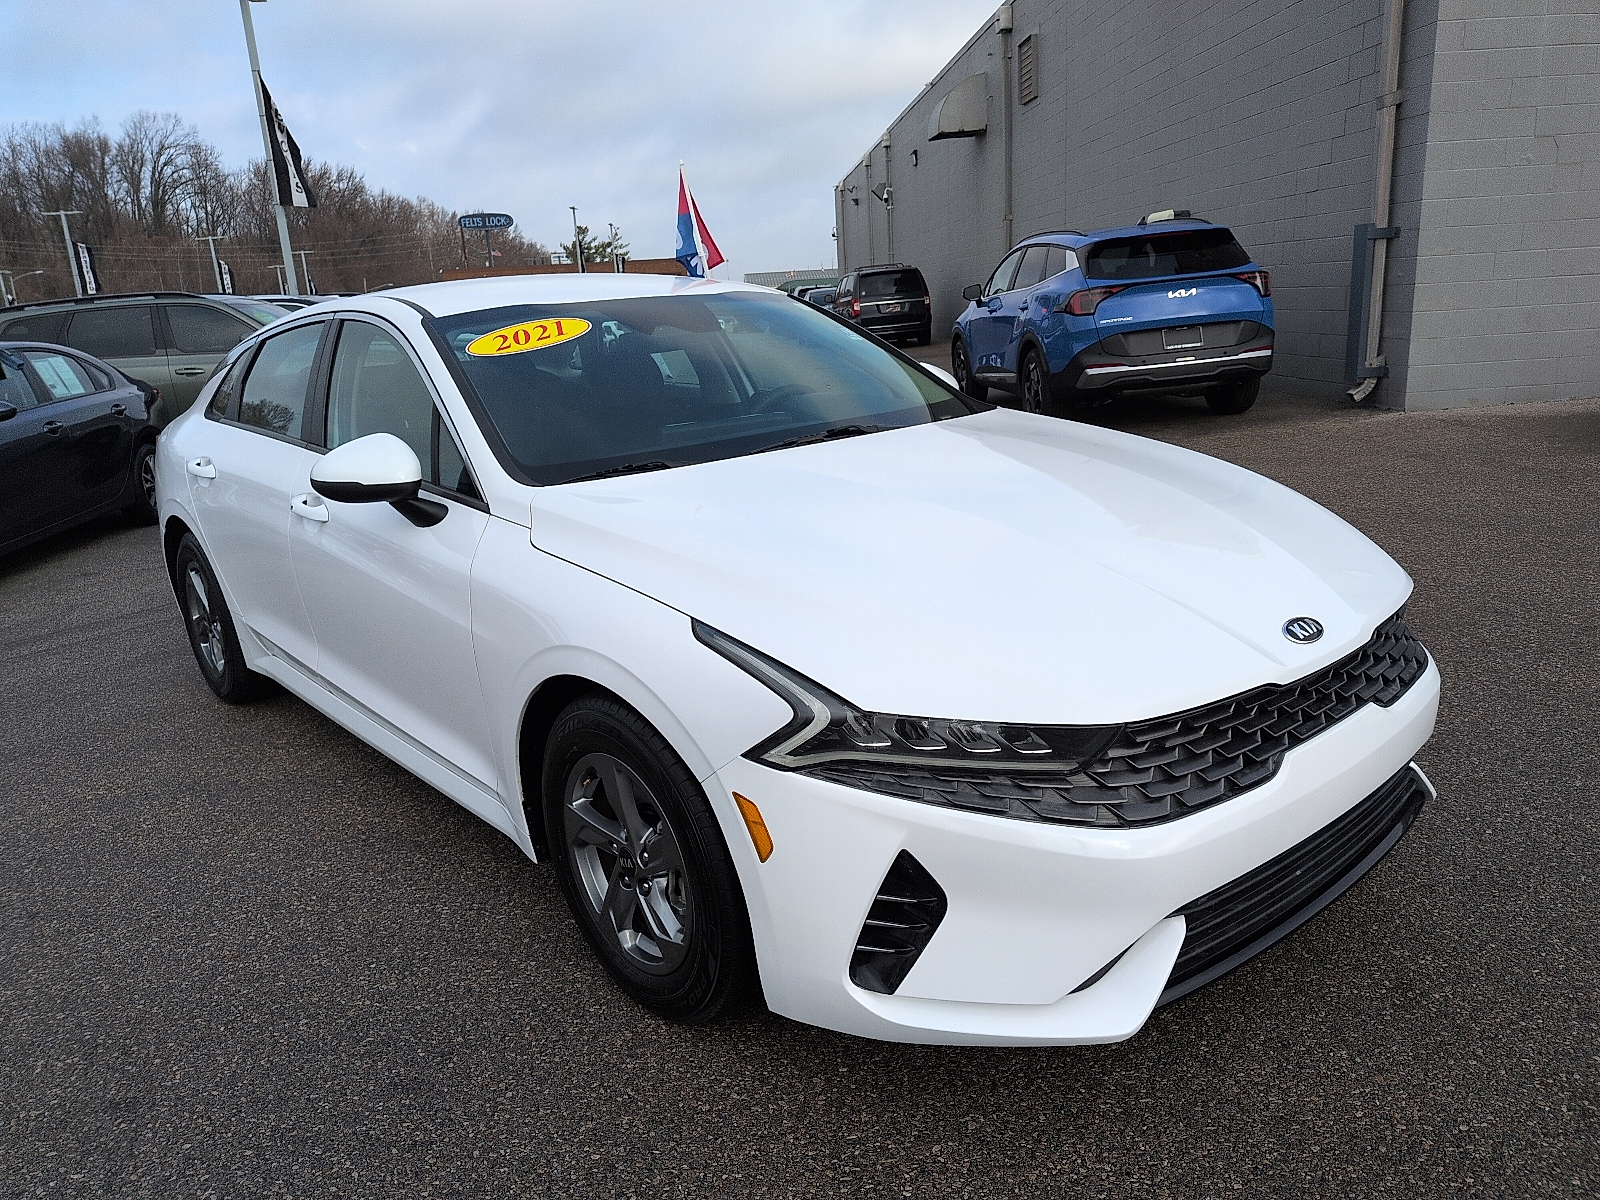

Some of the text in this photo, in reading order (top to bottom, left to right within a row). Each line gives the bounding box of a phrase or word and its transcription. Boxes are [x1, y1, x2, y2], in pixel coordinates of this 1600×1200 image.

[460, 217, 483, 227] FELTS
[486, 216, 507, 226] LOCK
[1167, 287, 1198, 299] KIA
[492, 320, 568, 352] 2021
[1288, 618, 1322, 640] KIA
[619, 857, 634, 869] KIA
